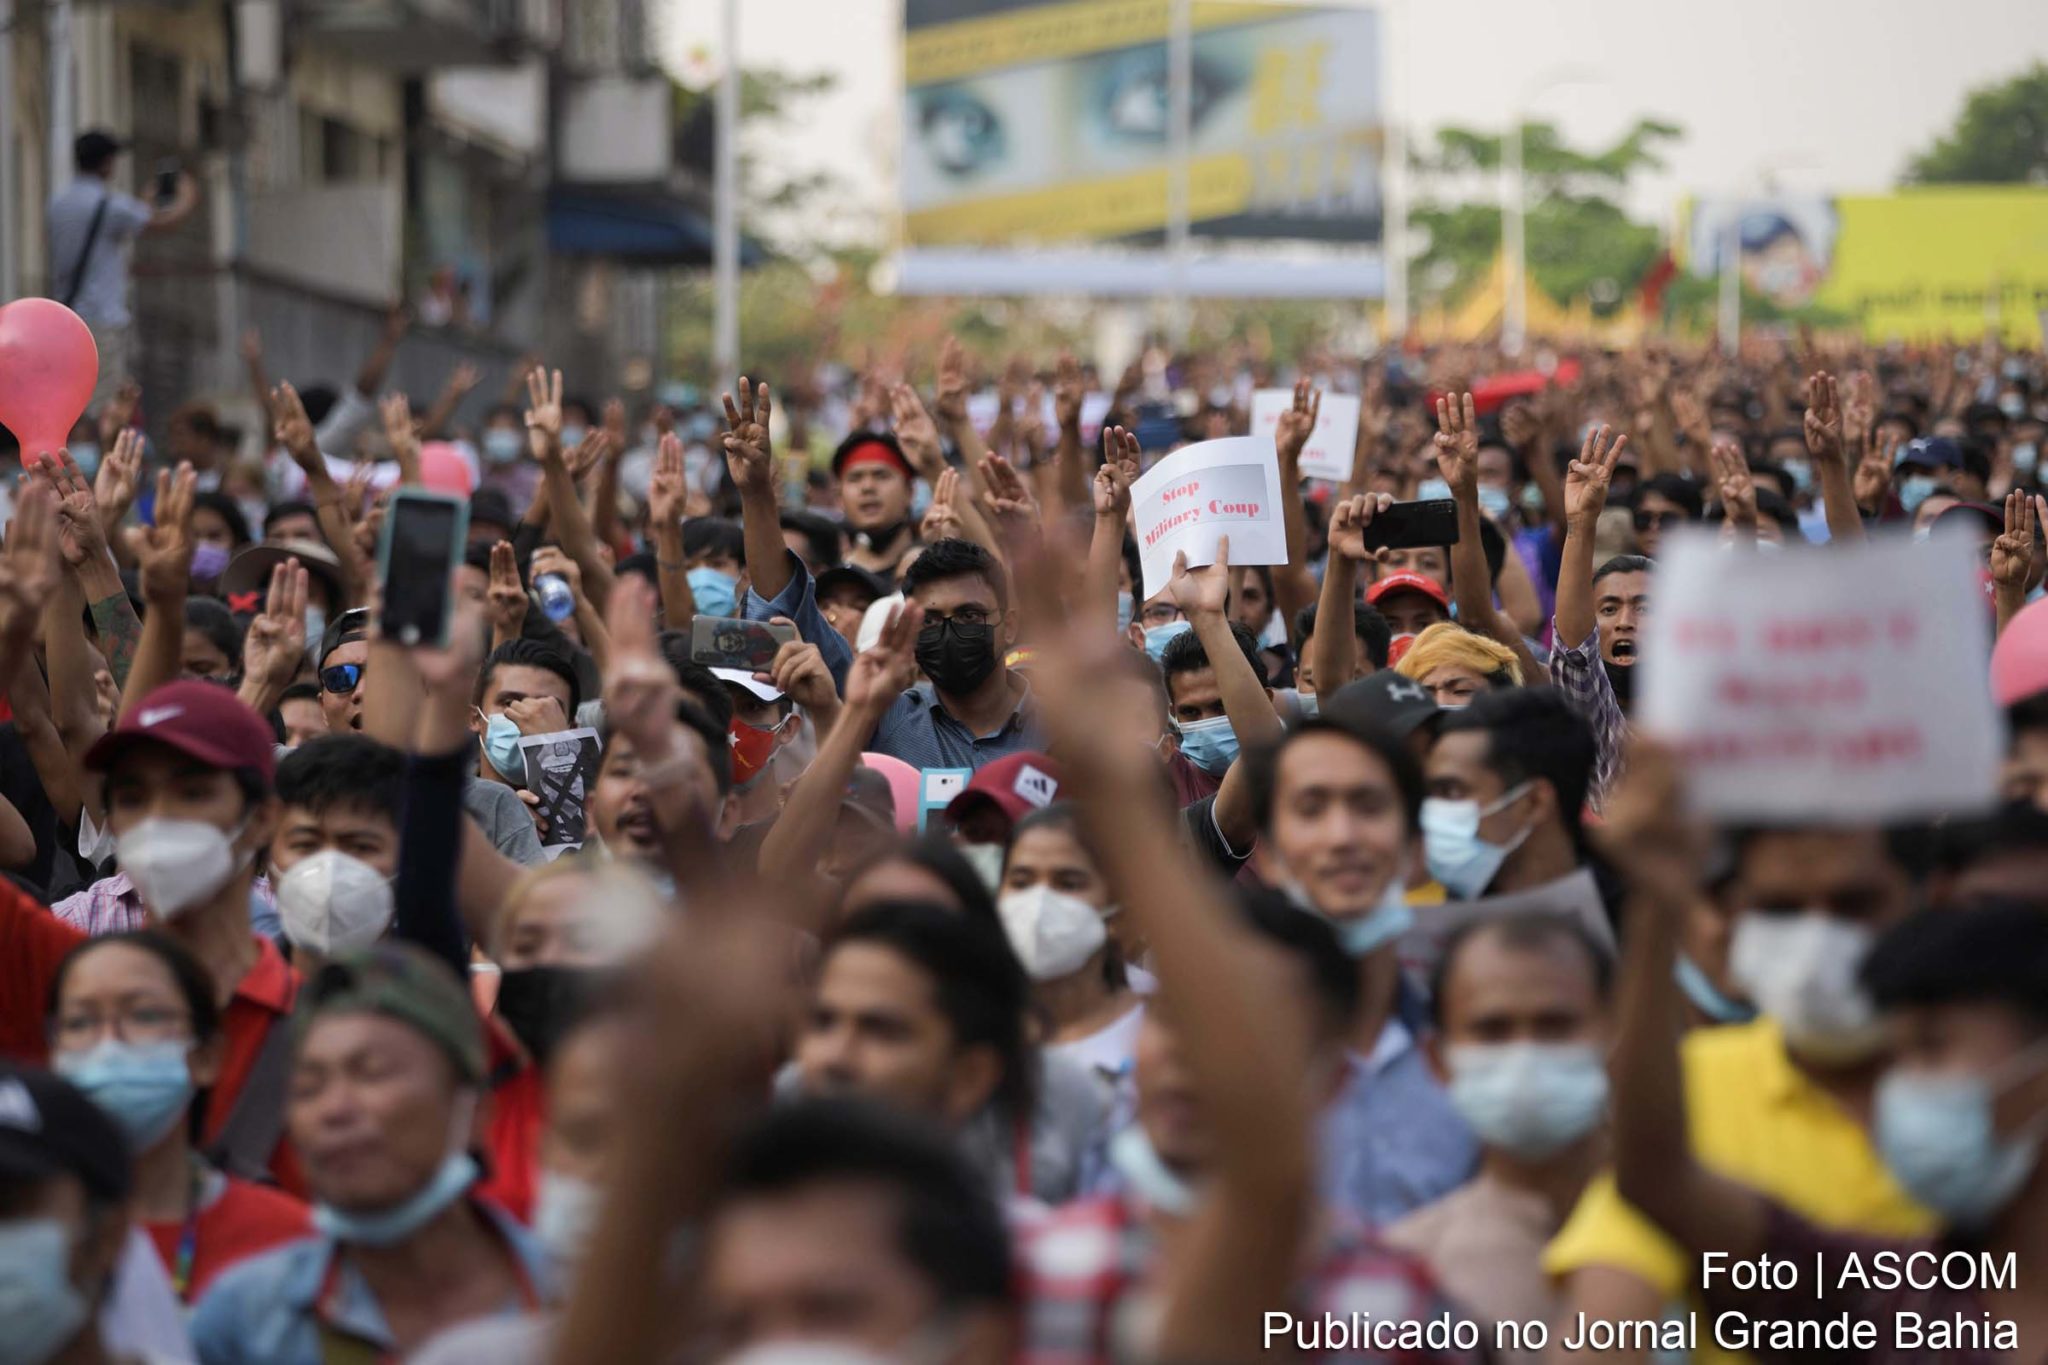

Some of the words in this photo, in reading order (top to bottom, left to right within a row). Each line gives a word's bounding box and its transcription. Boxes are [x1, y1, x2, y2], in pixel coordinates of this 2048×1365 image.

[1161, 480, 1200, 505] Stop
[1144, 507, 1201, 549] Military
[1208, 499, 1260, 517] Coup
